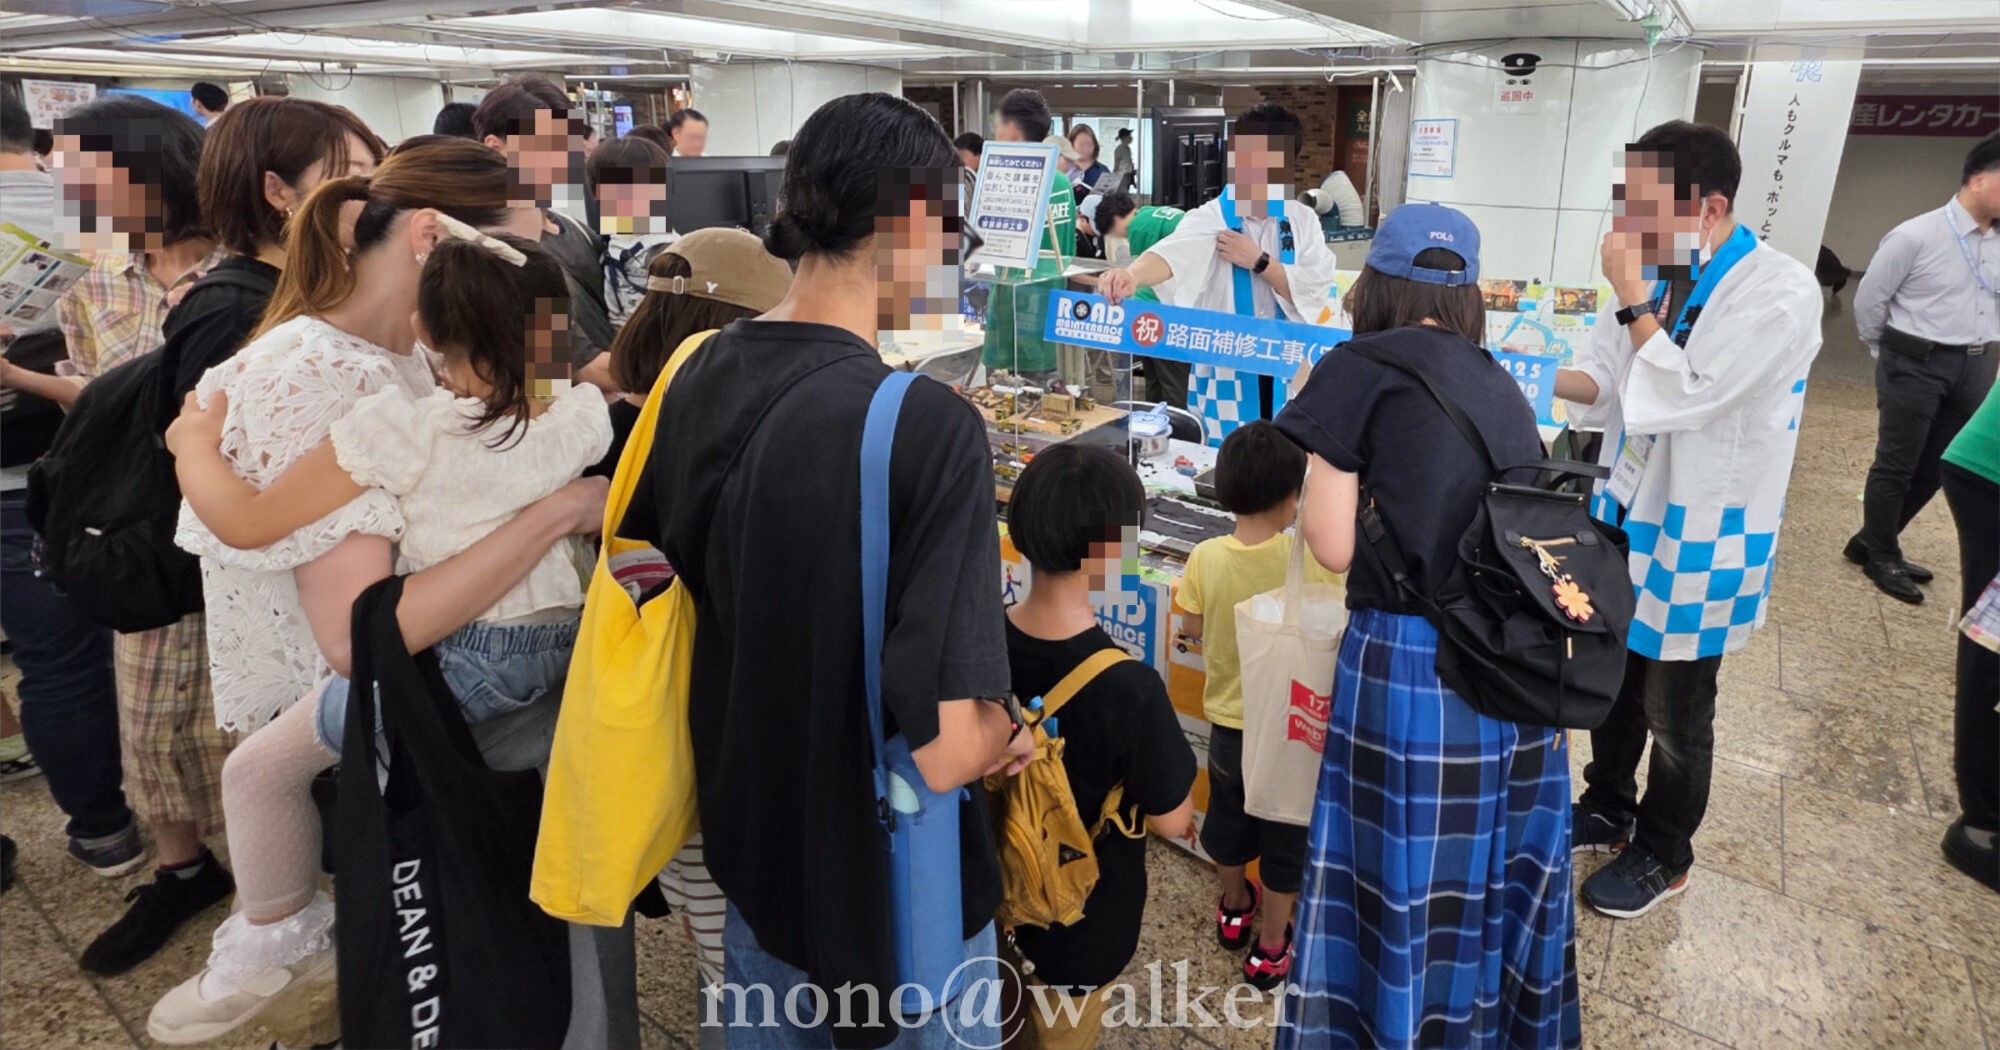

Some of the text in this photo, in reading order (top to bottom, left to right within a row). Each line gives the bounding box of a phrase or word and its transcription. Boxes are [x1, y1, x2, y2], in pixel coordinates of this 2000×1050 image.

[1501, 90, 1534, 102] 巡回中
[705, 281, 719, 293] Y
[1057, 297, 1125, 326] ROAD
[1056, 318, 1124, 337] MAINTENANCE
[1136, 316, 1160, 343] 祝
[393, 859, 434, 959] DEAN
[407, 963, 438, 993] &
